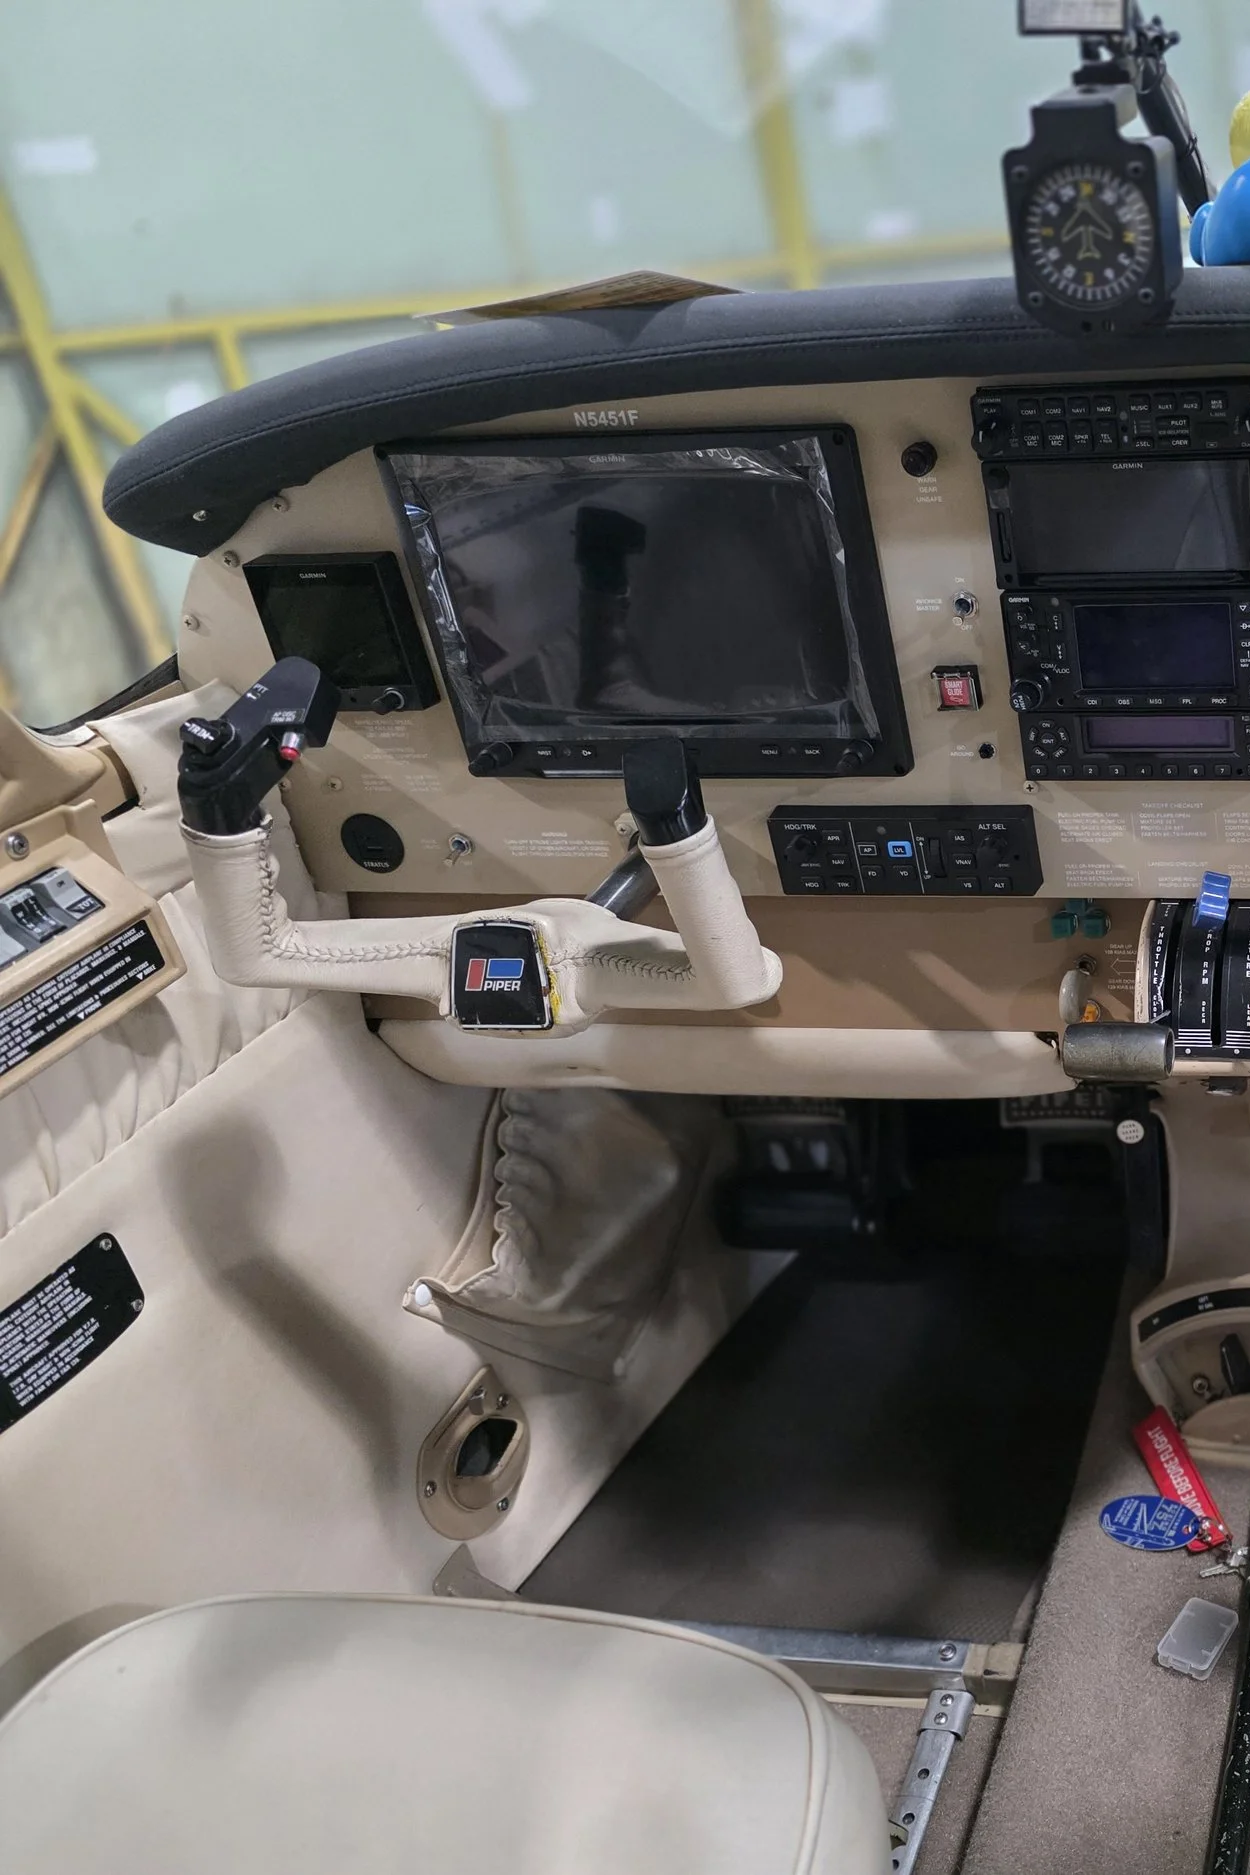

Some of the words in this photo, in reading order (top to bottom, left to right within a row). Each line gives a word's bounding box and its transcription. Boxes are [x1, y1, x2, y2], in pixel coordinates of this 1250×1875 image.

[573, 410, 638, 427] N5451F
[253, 683, 270, 693] PTT
[188, 724, 210, 740] TRIM
[1153, 926, 1165, 984] THROTTLE
[484, 981, 520, 991] PIPER
[1148, 1428, 1174, 1461] FLIGHT
[1164, 1458, 1192, 1494] BEFORE
[1180, 1491, 1205, 1521] MOVE
